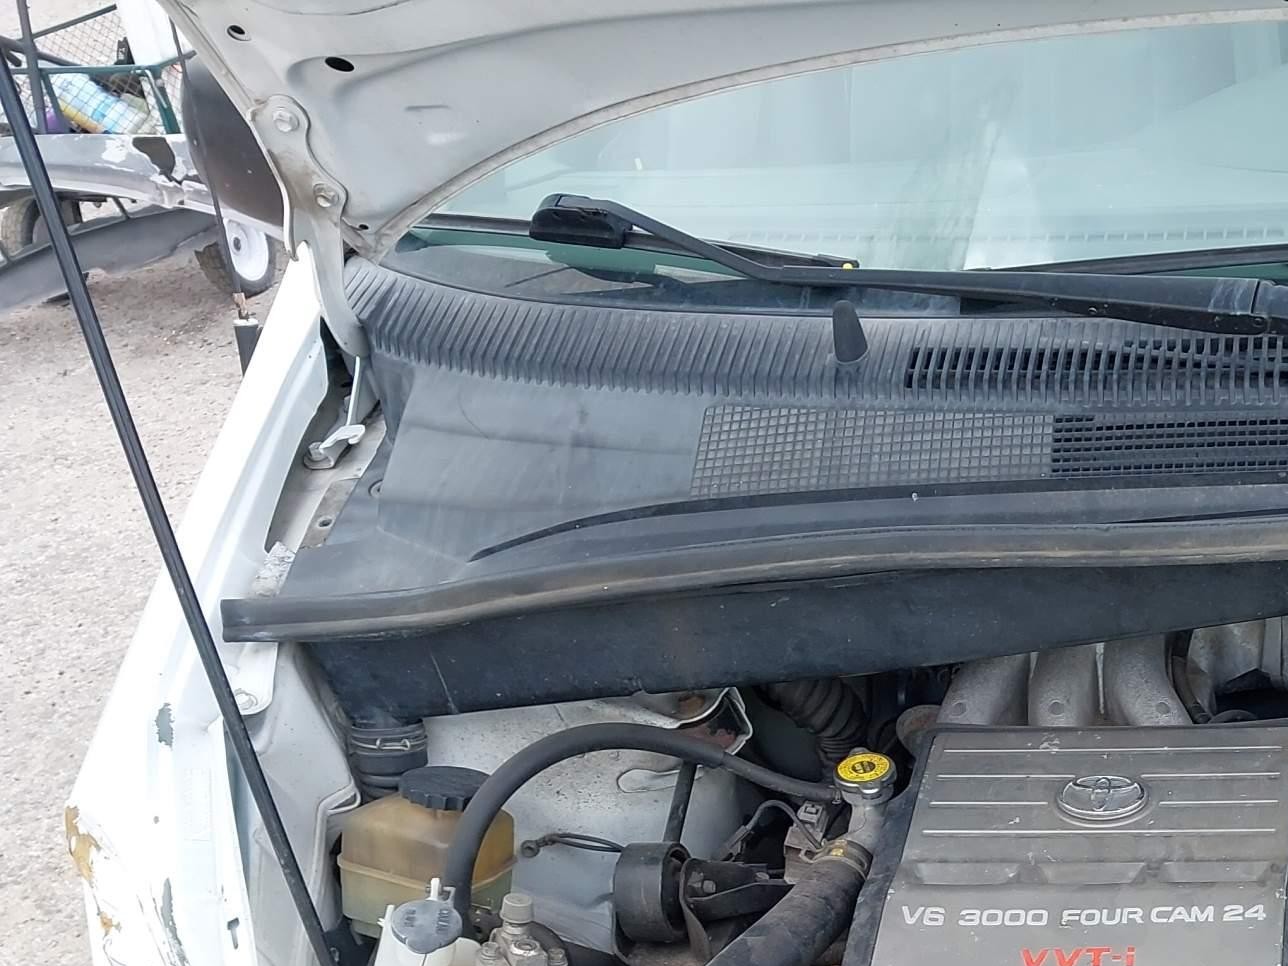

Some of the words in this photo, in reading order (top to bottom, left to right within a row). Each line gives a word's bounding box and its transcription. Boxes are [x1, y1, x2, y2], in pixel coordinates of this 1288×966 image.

[902, 905, 945, 926] V6
[958, 908, 1049, 926] 3000
[1060, 907, 1144, 927] FOUR
[1150, 905, 1215, 923] CAM
[1222, 904, 1267, 921] 24
